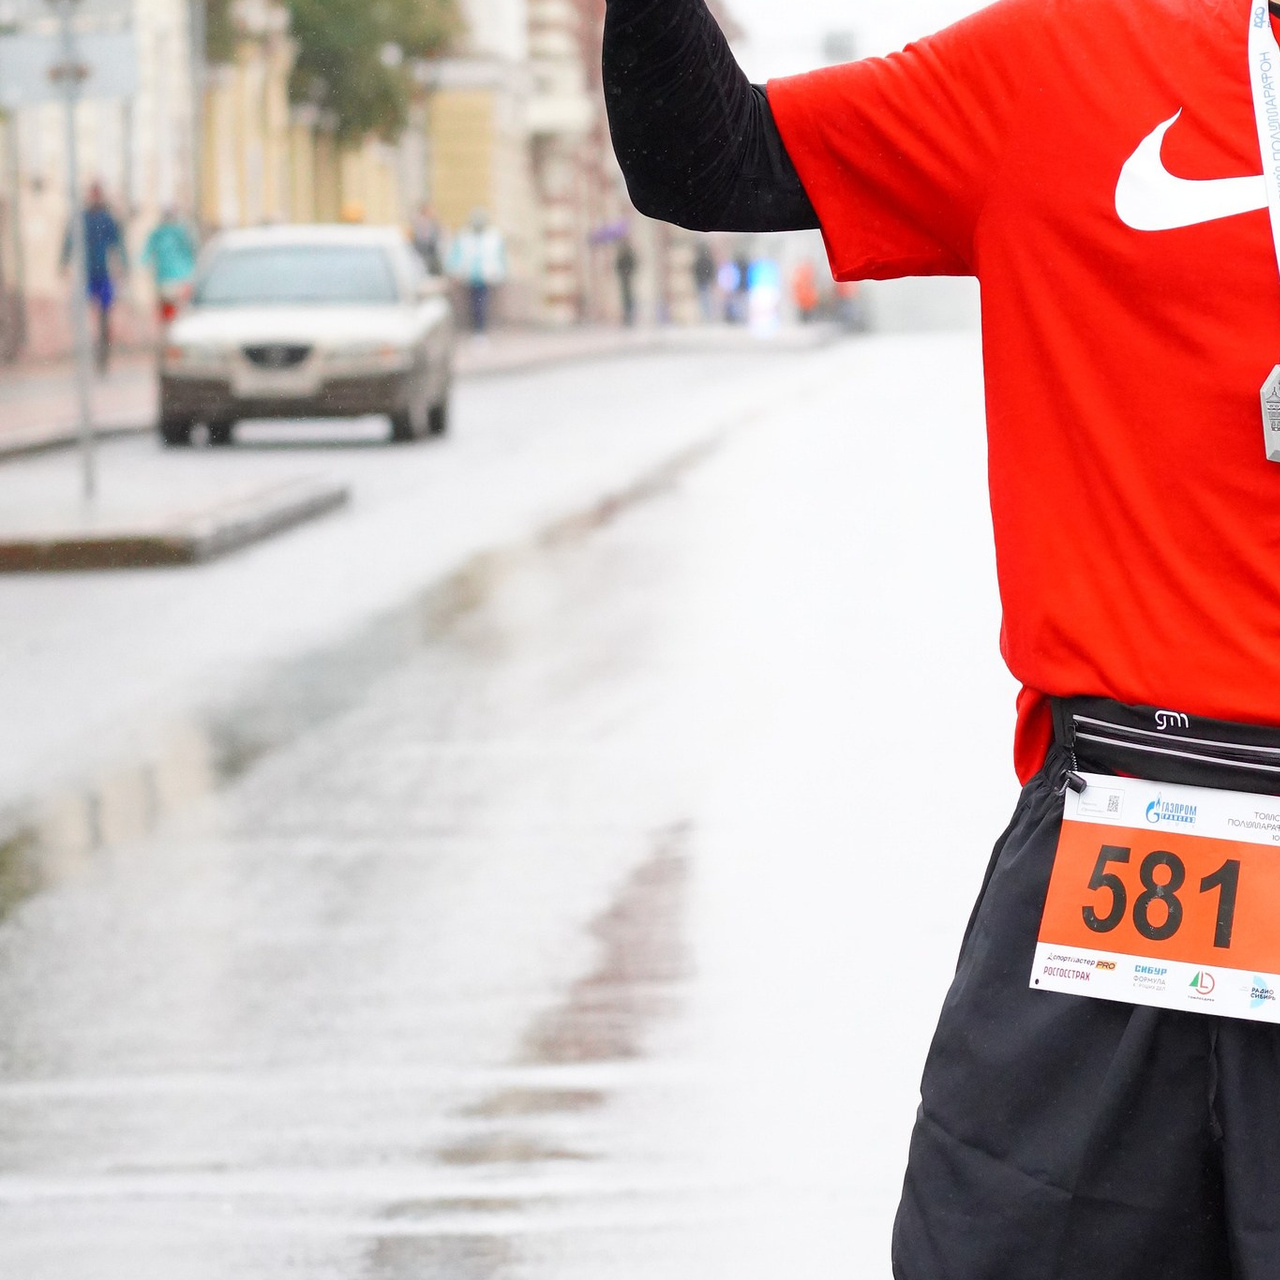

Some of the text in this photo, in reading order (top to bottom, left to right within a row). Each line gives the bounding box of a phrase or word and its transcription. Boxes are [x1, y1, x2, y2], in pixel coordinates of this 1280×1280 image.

[1161, 801, 1197, 816] ГАЗПРОМ
[1272, 834, 1280, 842] 10
[1082, 844, 1240, 949] 581
[1096, 960, 1117, 970] PRO
[1134, 964, 1168, 976] СИБУР
[1043, 966, 1091, 981] РОСГОССТРАХ
[1251, 987, 1274, 995] РАДИО
[1250, 993, 1276, 1001] СИБИРЬ
